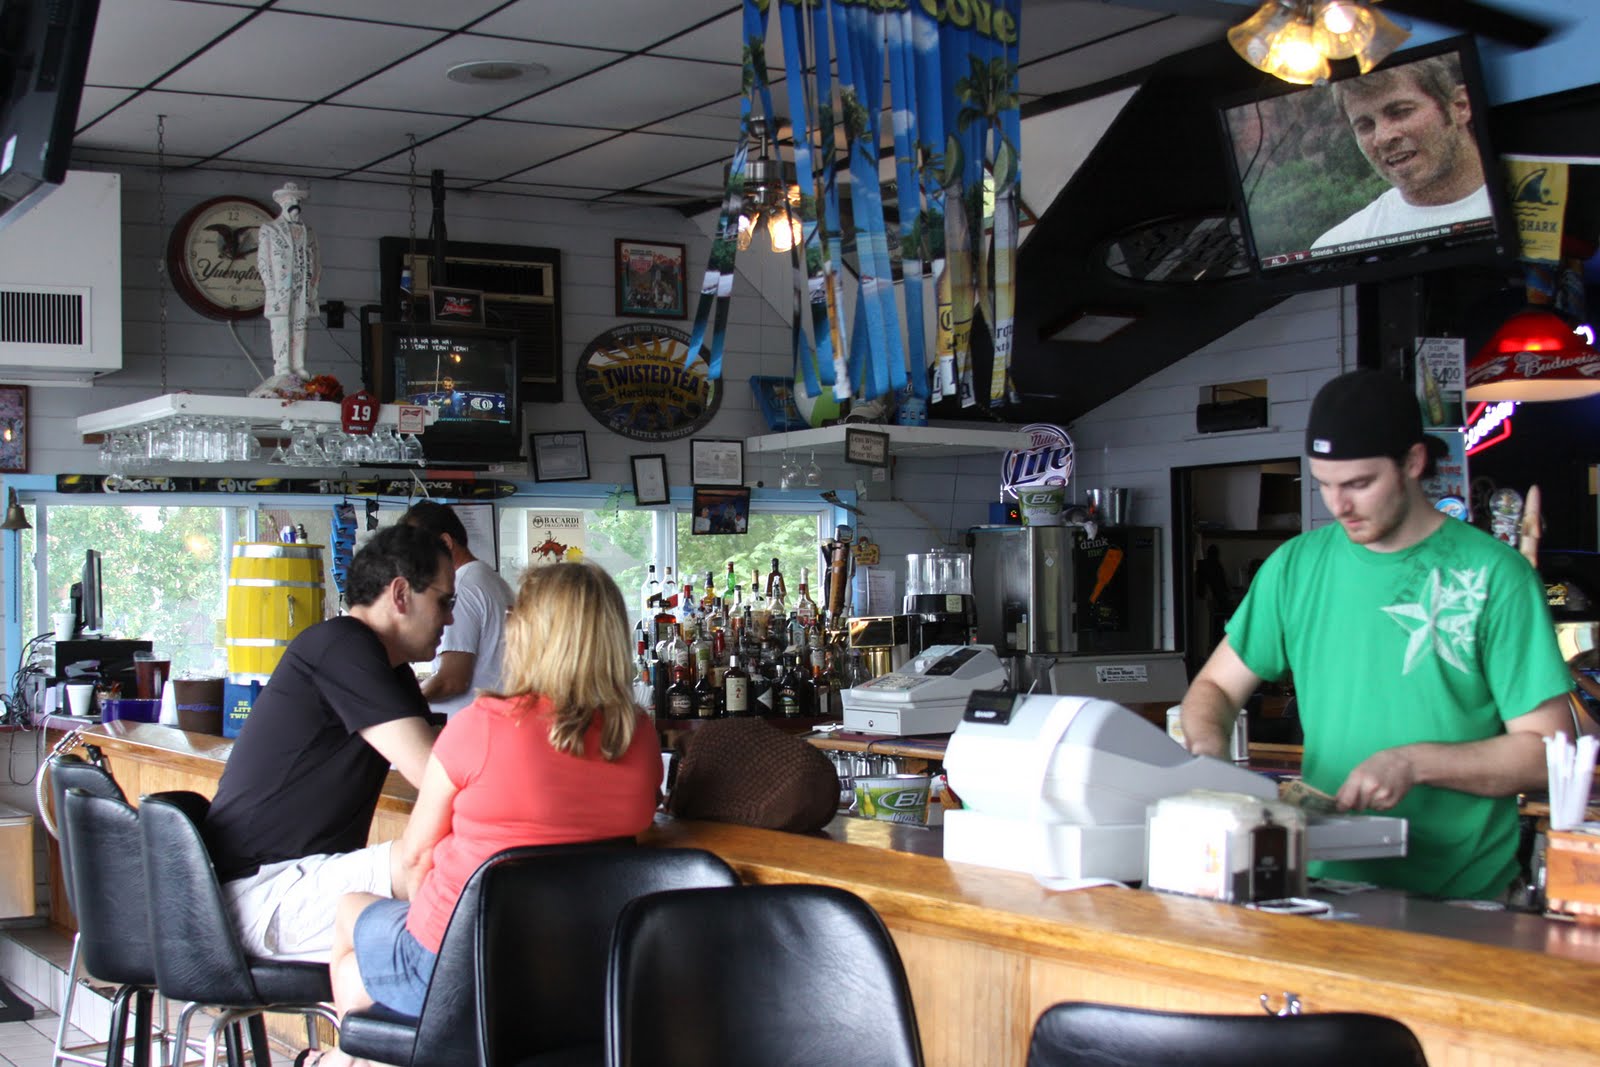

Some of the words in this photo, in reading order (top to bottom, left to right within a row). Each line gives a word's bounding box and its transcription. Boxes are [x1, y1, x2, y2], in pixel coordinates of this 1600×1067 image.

[198, 258, 265, 285] Yuenglin
[603, 363, 672, 389] TWISTED
[672, 365, 700, 395] TEA
[351, 404, 372, 422] 19
[1030, 432, 1064, 447] Miller
[544, 517, 580, 525] BACARDI
[1080, 538, 1109, 550] drink
